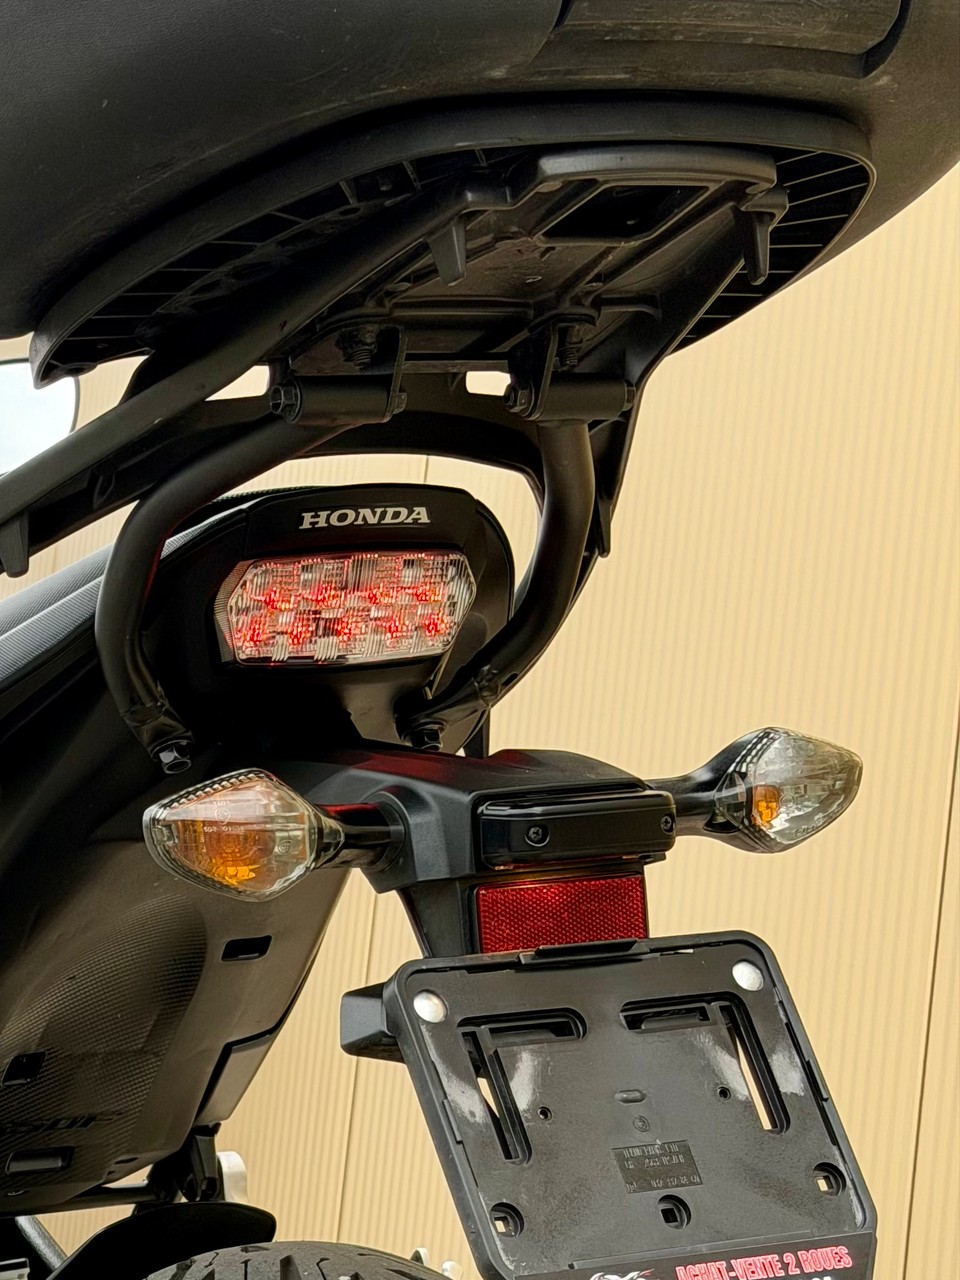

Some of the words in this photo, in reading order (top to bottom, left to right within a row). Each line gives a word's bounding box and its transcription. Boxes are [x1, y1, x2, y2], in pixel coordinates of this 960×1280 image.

[299, 507, 431, 529] HONDA
[783, 1253, 800, 1275] 2
[798, 1246, 853, 1274] ROUES
